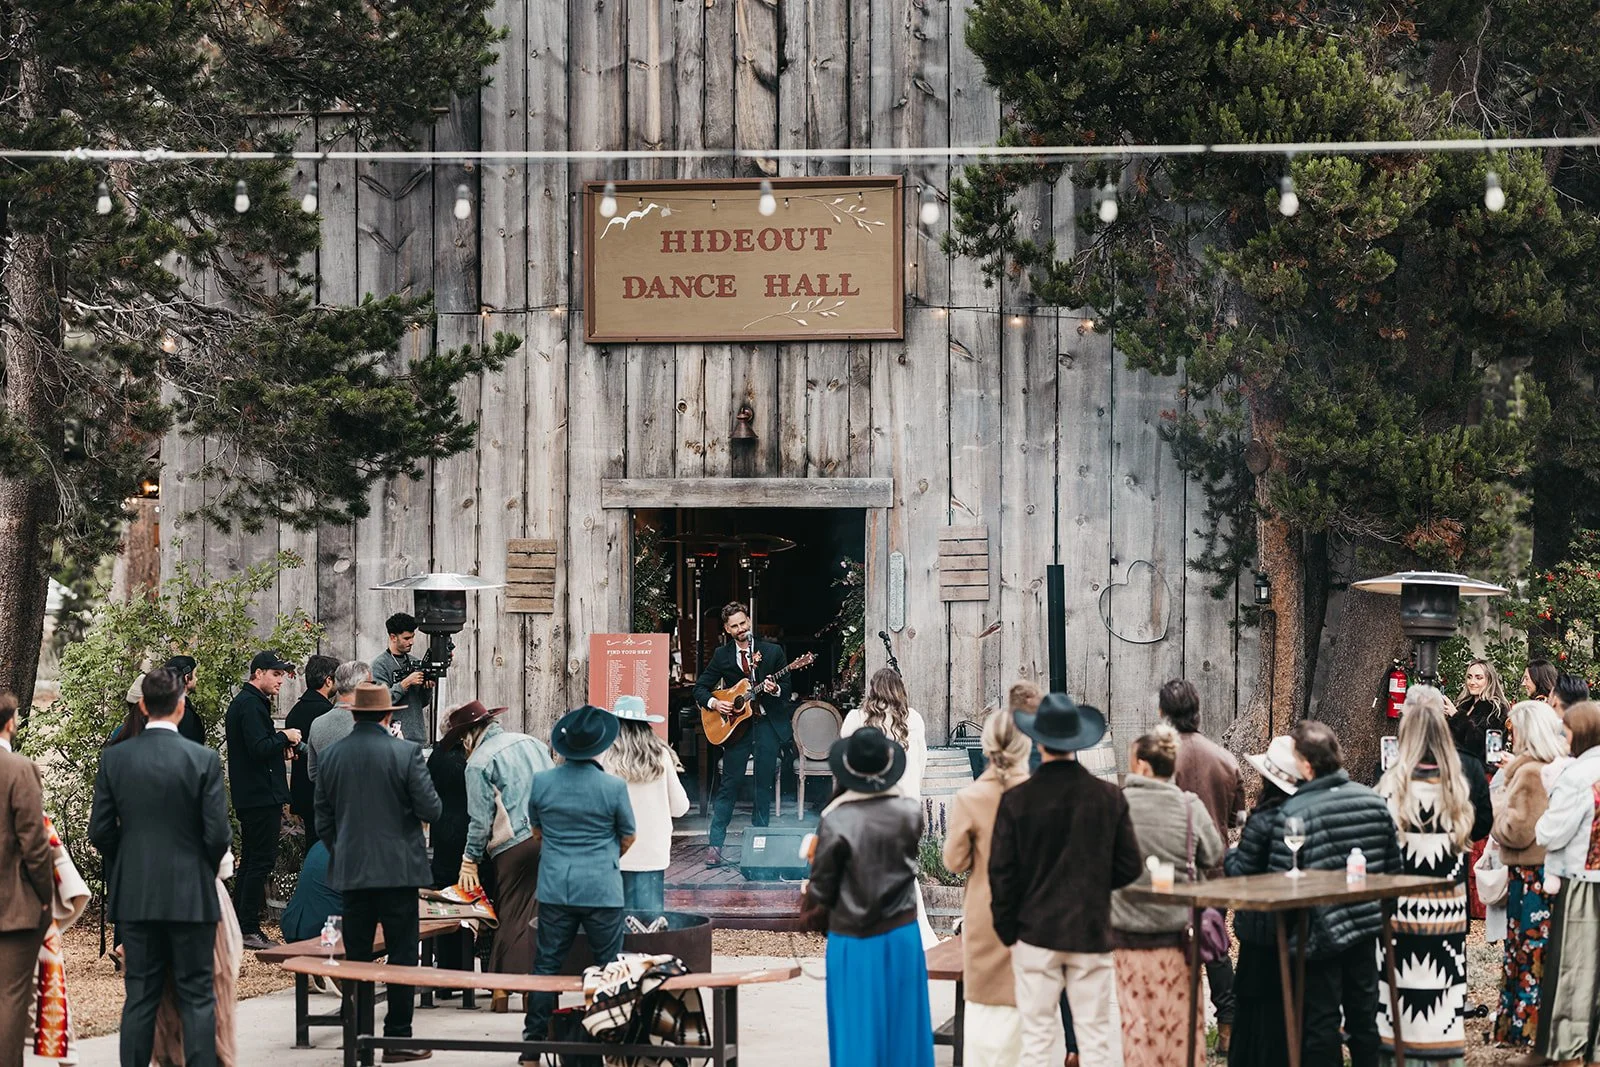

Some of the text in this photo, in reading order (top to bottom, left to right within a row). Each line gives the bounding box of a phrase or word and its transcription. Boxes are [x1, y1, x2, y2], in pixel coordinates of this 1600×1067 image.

[660, 227, 832, 253] HIDEOUT
[622, 273, 860, 299] DANCE HALL
